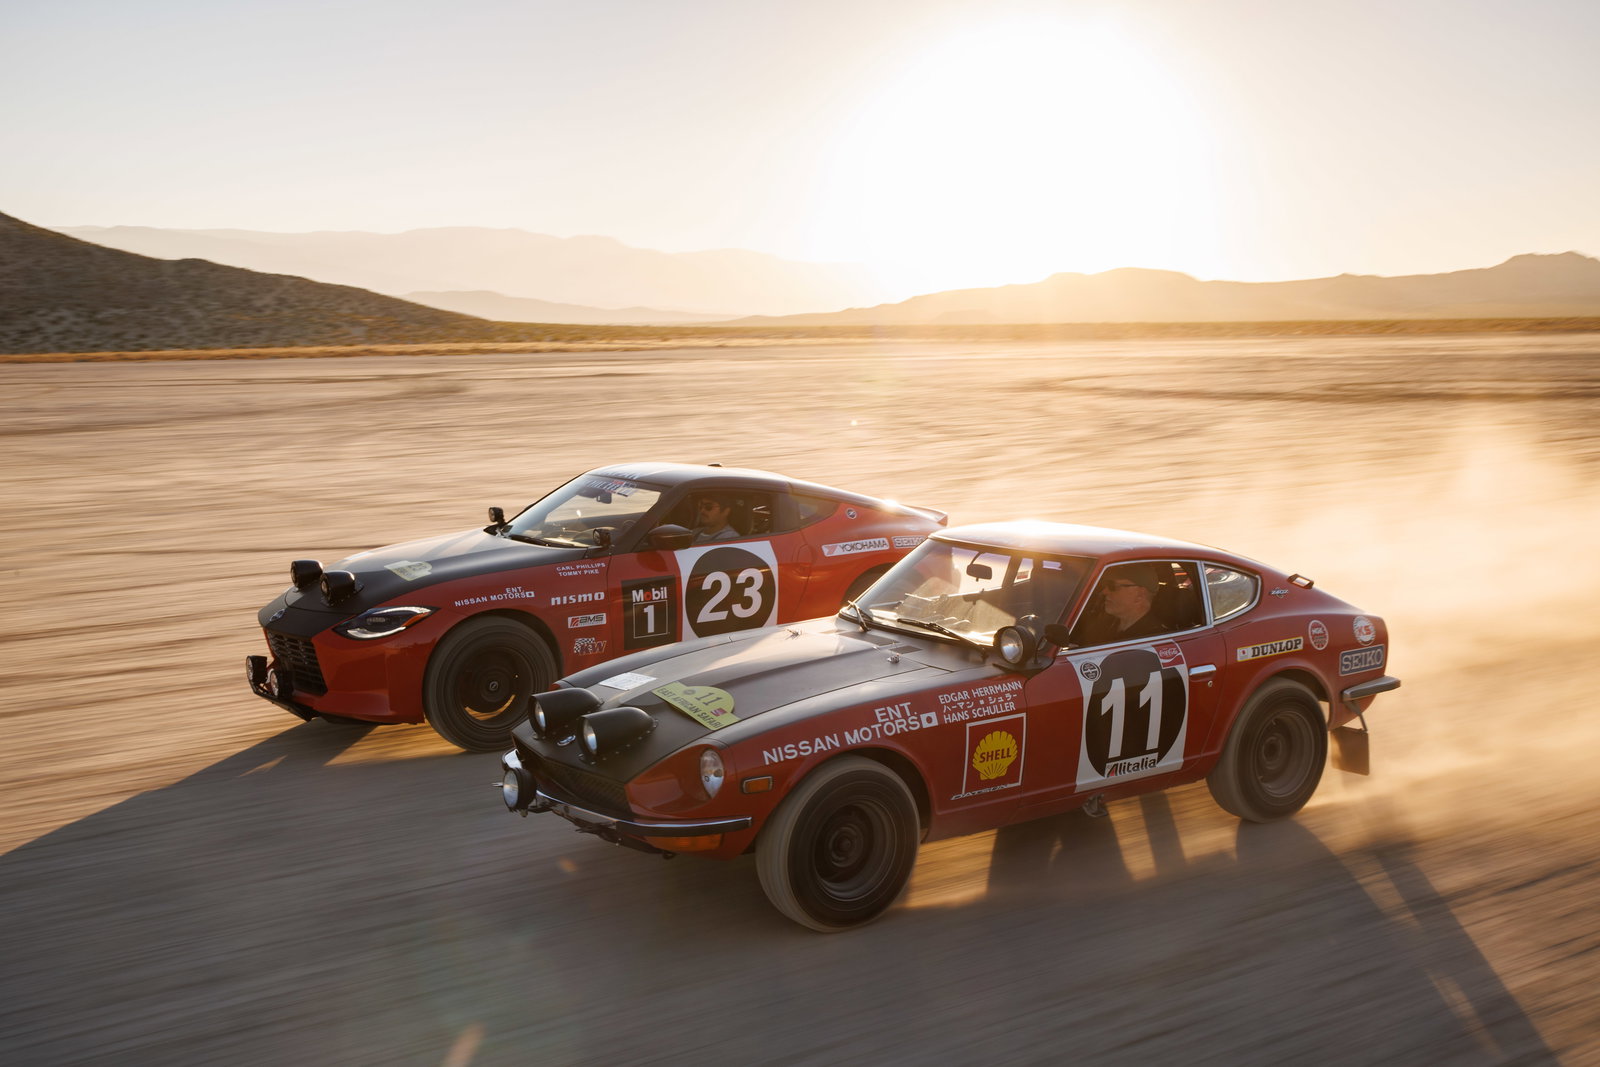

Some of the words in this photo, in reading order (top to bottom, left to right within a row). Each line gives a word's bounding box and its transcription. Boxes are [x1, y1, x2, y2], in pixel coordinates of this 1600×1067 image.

[840, 540, 888, 553] YOKOHAMA
[556, 564, 574, 572] CARL
[575, 562, 606, 570] PHILLIPS
[583, 568, 599, 576] PIKE
[454, 596, 488, 607] NISSAN
[490, 590, 526, 602] MOTORS
[551, 591, 605, 606] nismo
[632, 586, 668, 603] Mobil
[696, 568, 764, 624] 23
[643, 605, 655, 634] 1
[1251, 638, 1303, 658] DUNLOP
[1342, 649, 1383, 672] SEIKO
[695, 691, 724, 707] 11
[938, 690, 970, 705] EDGAR
[971, 680, 1023, 698] HERRMANN
[656, 687, 678, 700] EAST
[674, 694, 702, 714] AFRICAN
[697, 711, 725, 729] SAFARI
[874, 701, 918, 723] ENT.
[943, 710, 970, 724] HANS
[1101, 670, 1163, 760] 11
[762, 733, 841, 766] NISSAN
[843, 714, 922, 745] MOTORS
[979, 747, 1012, 764] SHELL
[1107, 755, 1158, 778] Alitalia
